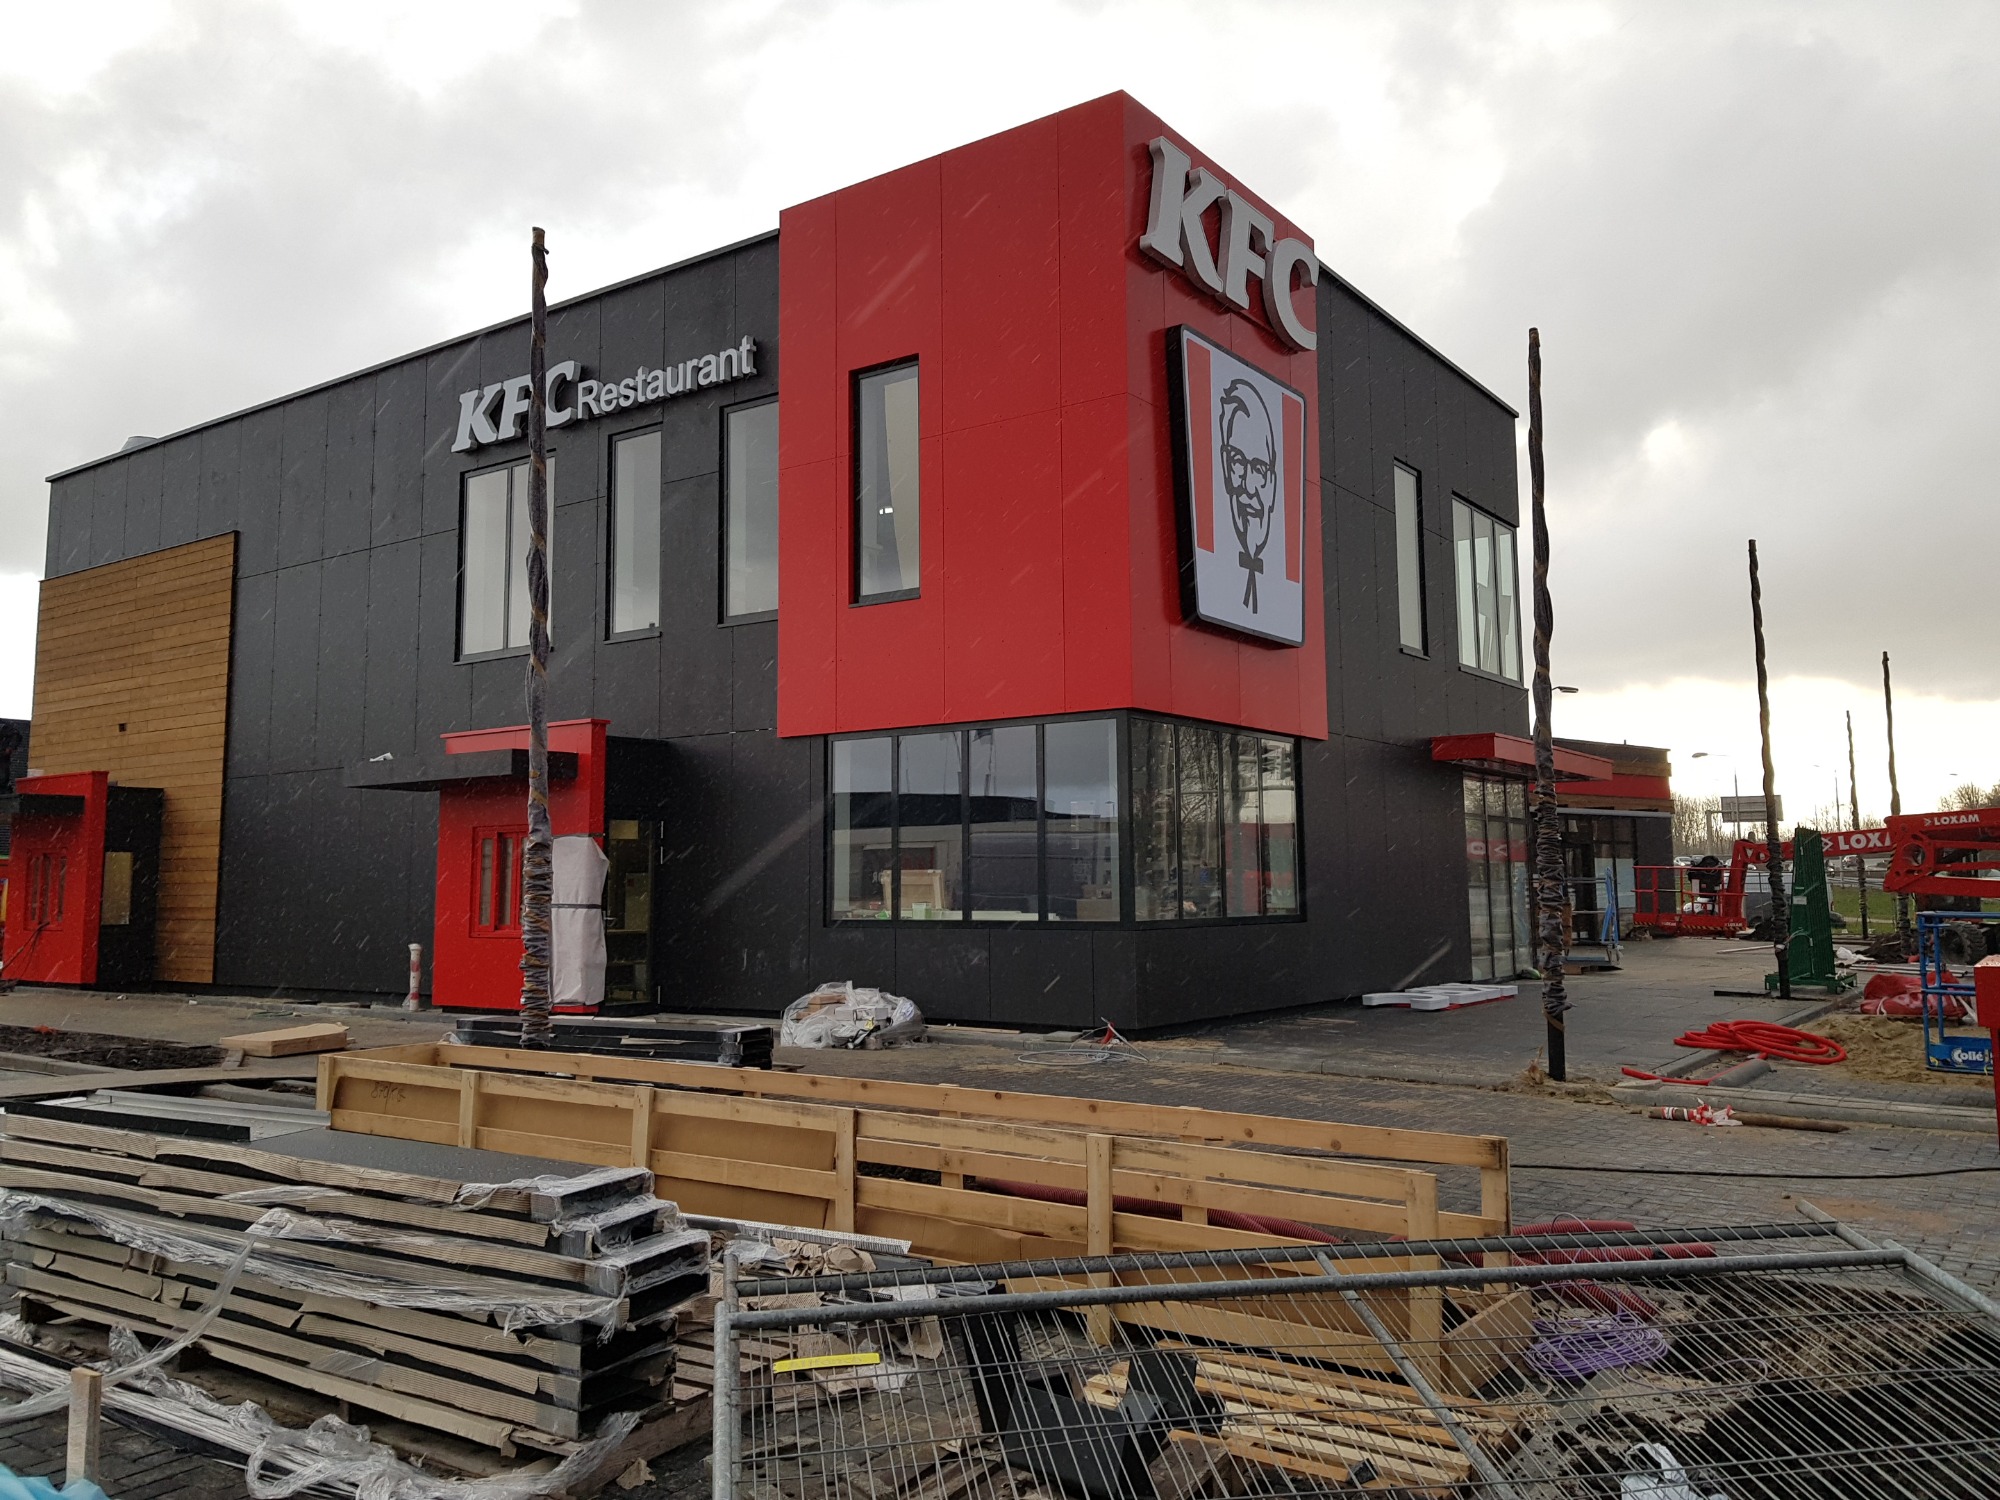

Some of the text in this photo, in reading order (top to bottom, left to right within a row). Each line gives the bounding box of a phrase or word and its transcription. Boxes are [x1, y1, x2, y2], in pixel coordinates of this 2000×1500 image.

[1140, 135, 1320, 351] KFC
[450, 335, 757, 453] KFC Restaurant
[1934, 813, 1980, 826] LOXAM
[1952, 1048, 1984, 1063] Collé
